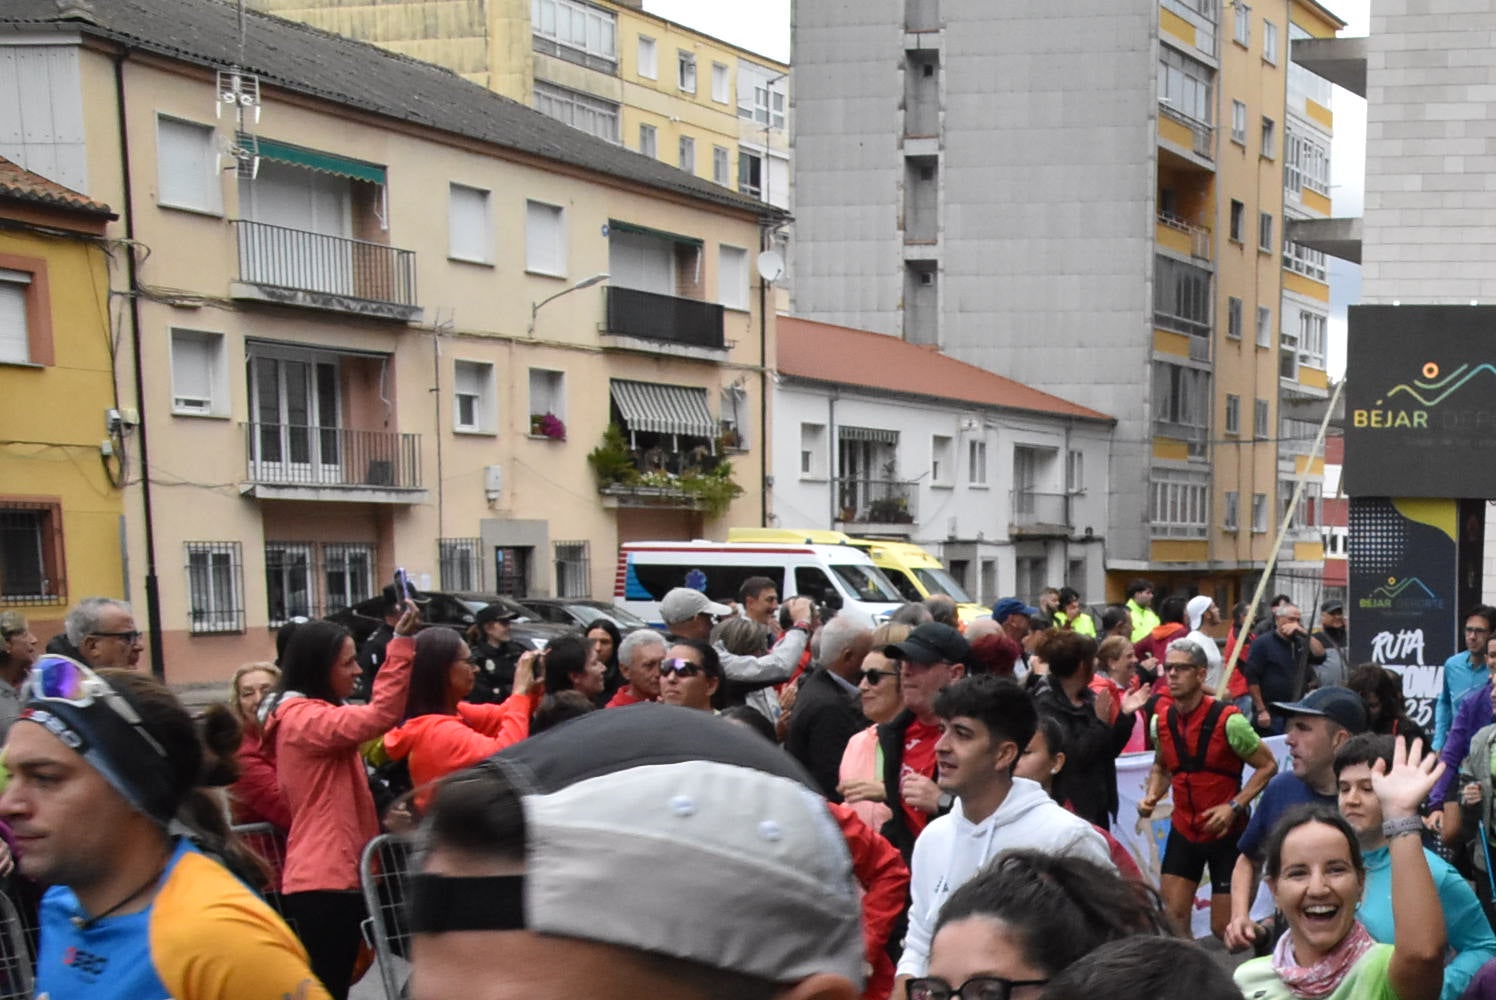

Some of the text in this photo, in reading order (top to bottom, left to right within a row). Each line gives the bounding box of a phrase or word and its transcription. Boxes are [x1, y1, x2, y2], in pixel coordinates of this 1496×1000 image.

[1353, 399, 1428, 429] BÉJAR
[1371, 628, 1425, 665] RUTA
[1404, 699, 1432, 727] 25
